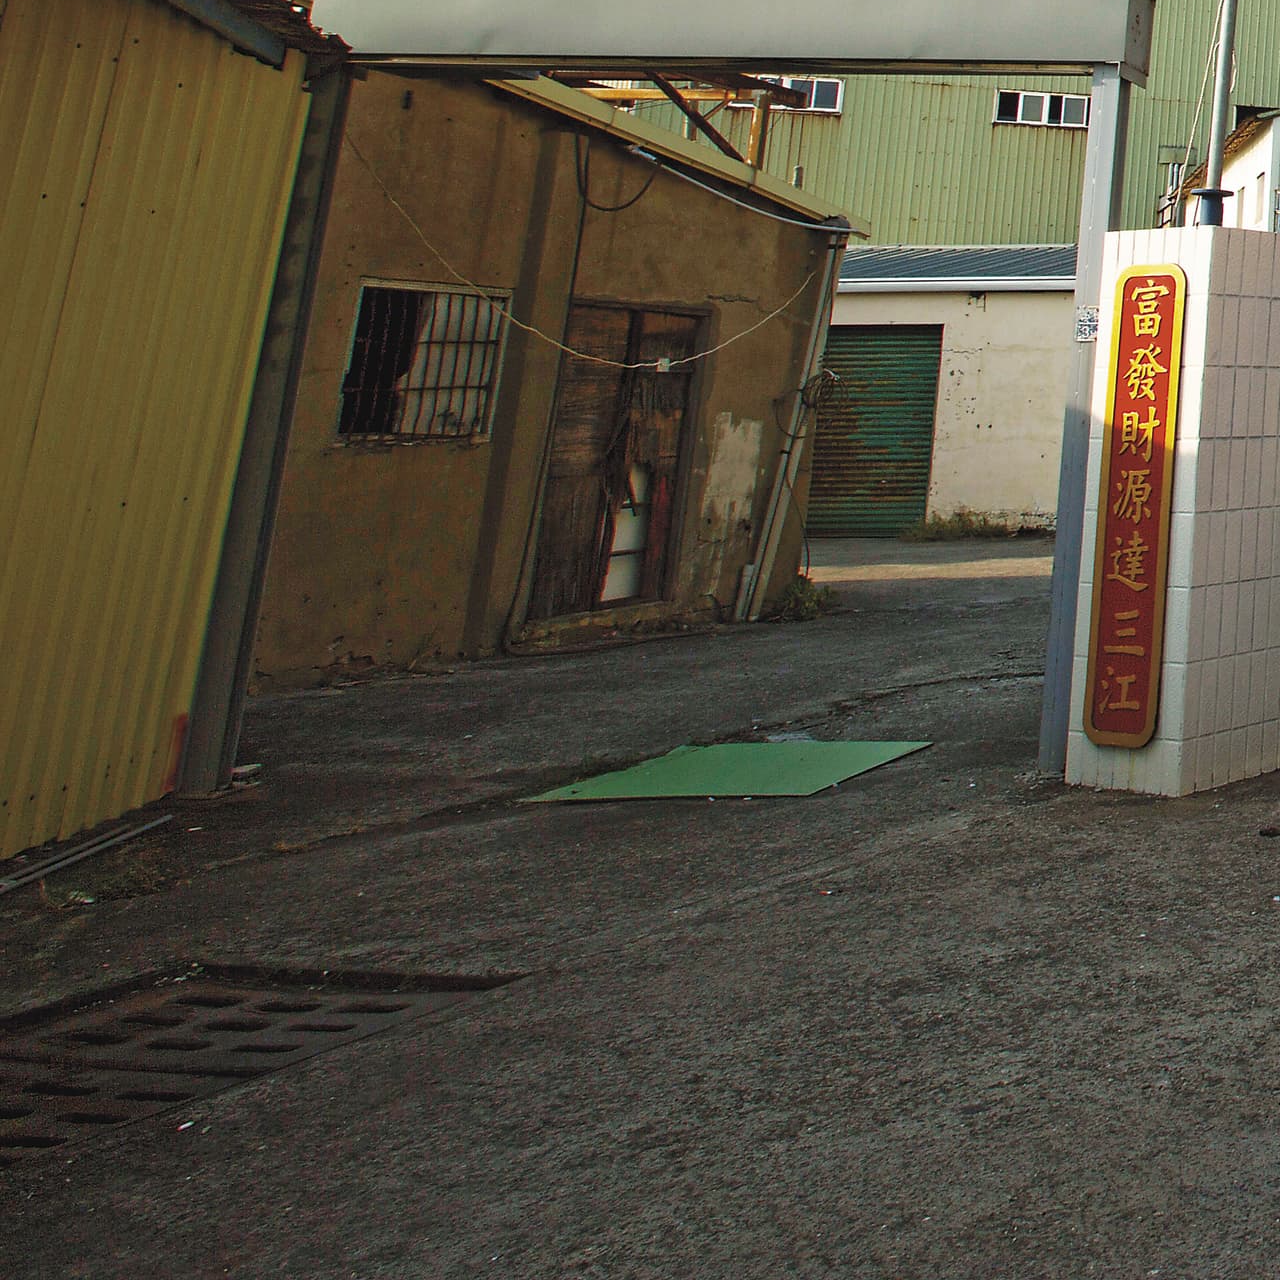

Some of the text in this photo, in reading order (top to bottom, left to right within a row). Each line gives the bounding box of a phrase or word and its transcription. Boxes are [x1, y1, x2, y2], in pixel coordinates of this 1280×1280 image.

[1100, 279, 1170, 716] 富發財源達三江
